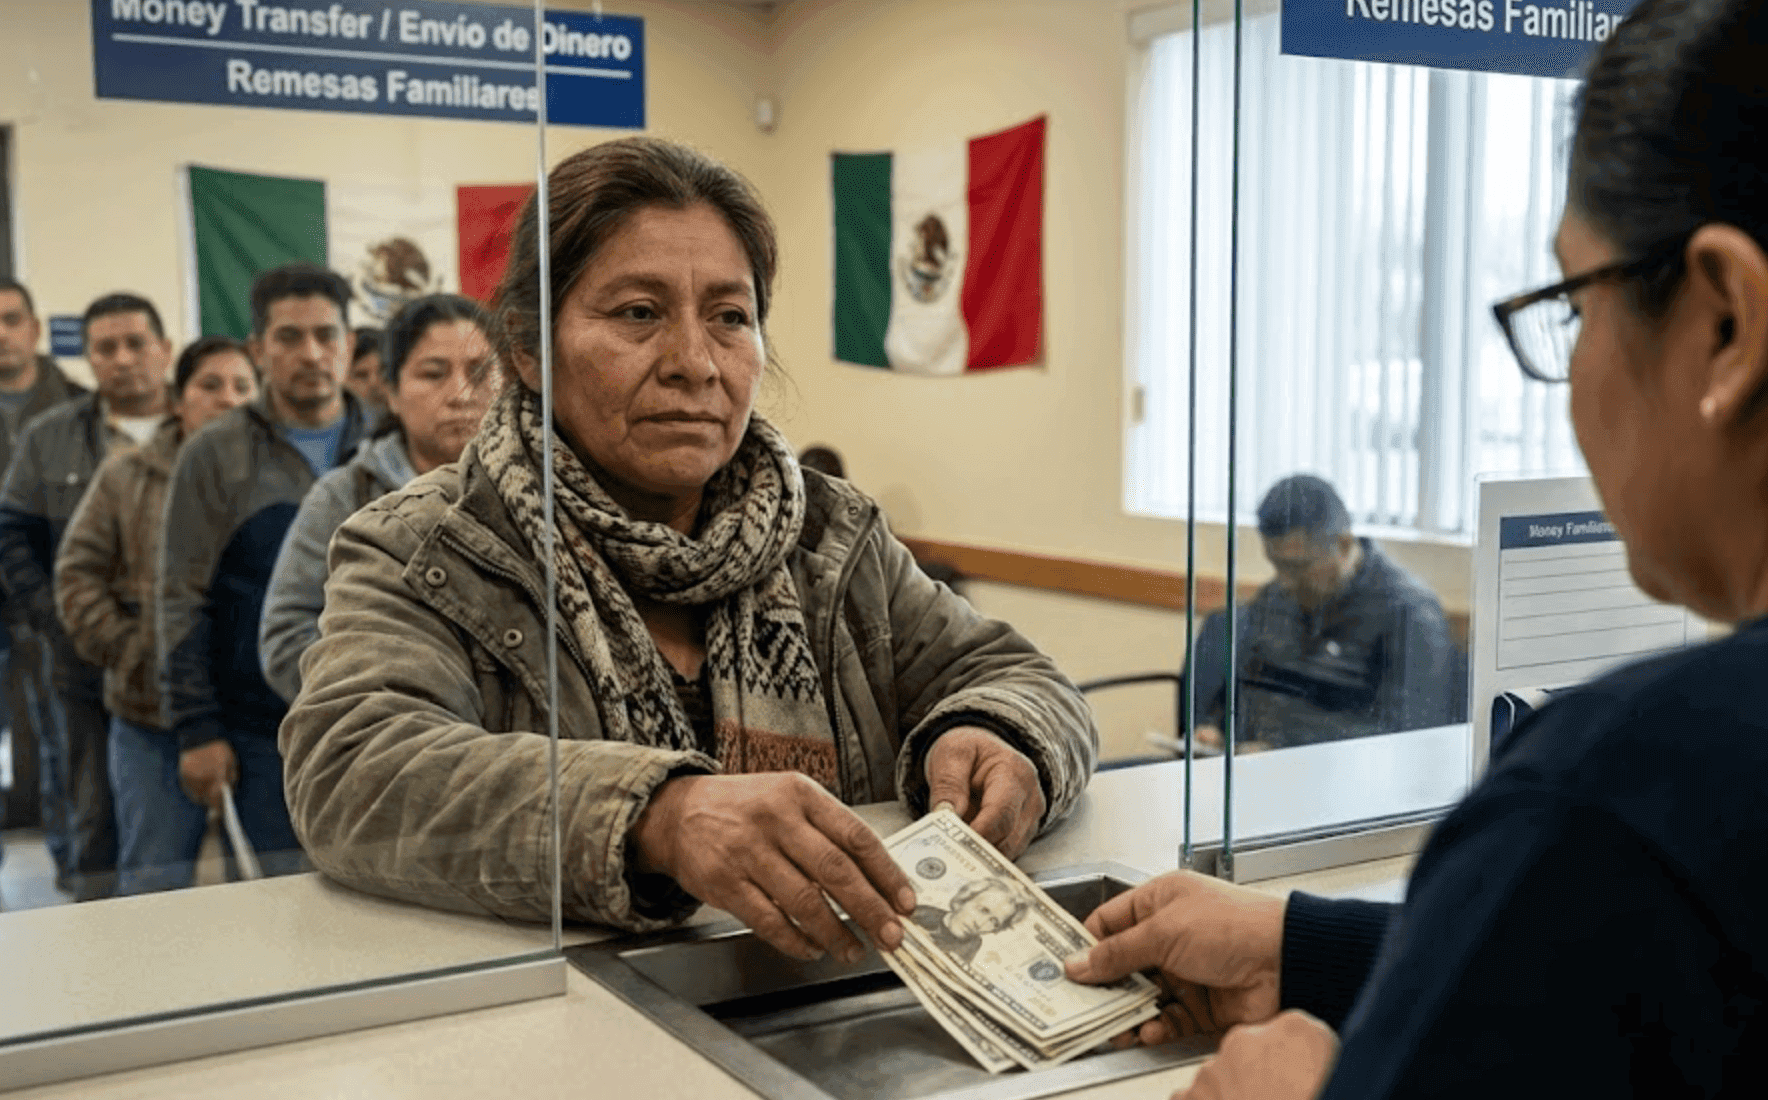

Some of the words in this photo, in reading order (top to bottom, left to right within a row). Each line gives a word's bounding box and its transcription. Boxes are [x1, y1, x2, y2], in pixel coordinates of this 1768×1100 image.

[111, 0, 227, 35] Money
[235, 0, 374, 38] Transfer
[379, 8, 392, 41] /
[493, 19, 530, 51] de
[541, 22, 632, 60] Dinero
[227, 58, 379, 101] Remesas
[387, 70, 542, 112] Familiares
